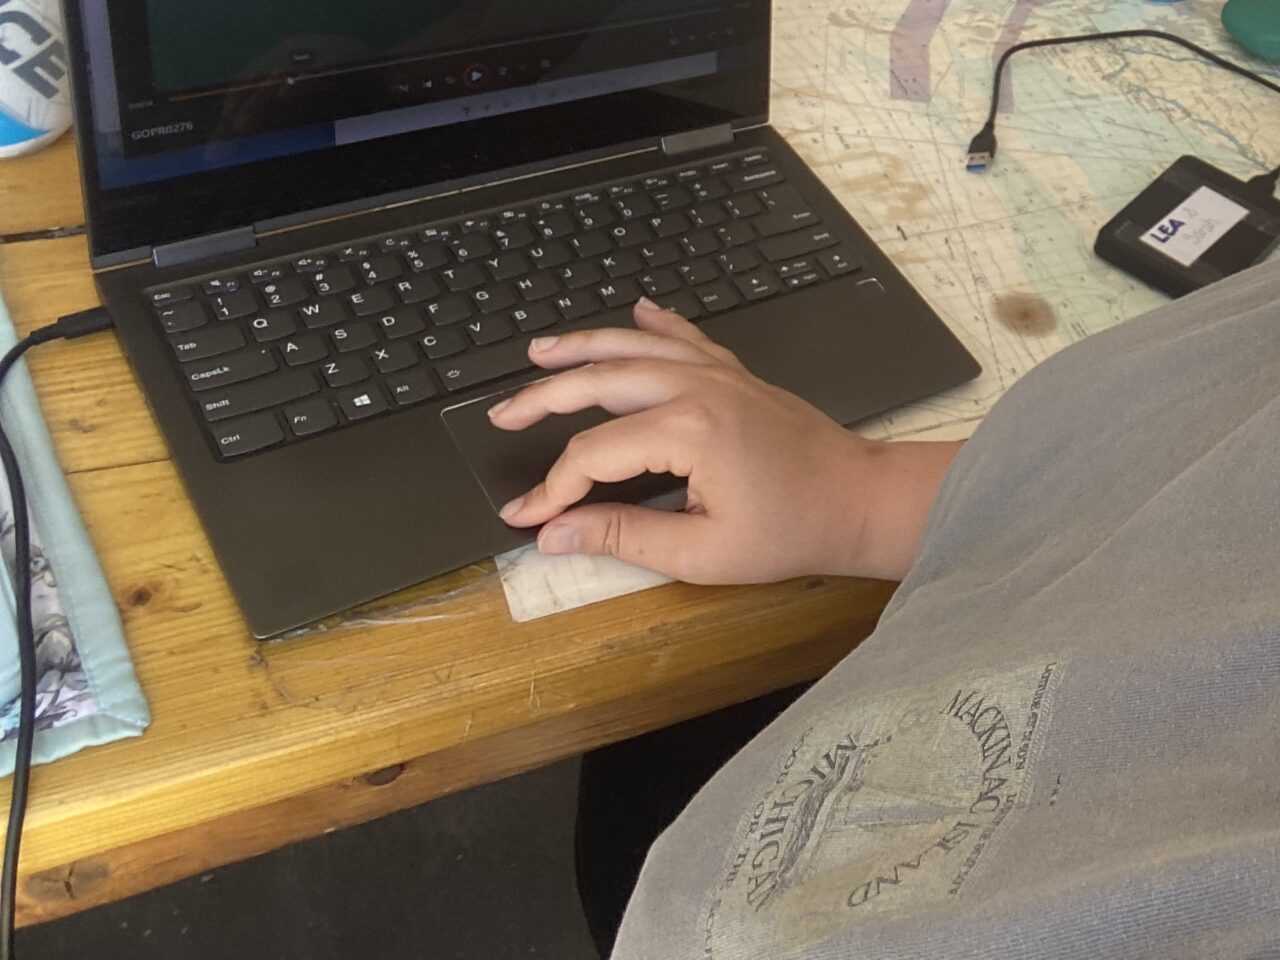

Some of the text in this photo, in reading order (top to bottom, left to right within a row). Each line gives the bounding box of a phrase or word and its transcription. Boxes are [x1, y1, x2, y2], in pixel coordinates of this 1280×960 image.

[131, 120, 194, 140] GOPR0276
[1150, 218, 1185, 244] LEA
[531, 248, 543, 258] U
[642, 248, 654, 257] L
[488, 258, 498, 268] Y
[603, 256, 616, 267] K
[444, 270, 454, 279] T
[564, 268, 572, 278] J
[320, 282, 330, 292] 3
[398, 282, 412, 292] R
[518, 278, 532, 290] H
[476, 290, 490, 300] G
[601, 286, 616, 296] M
[270, 294, 281, 304] 2
[351, 293, 364, 304] E
[558, 298, 572, 308] N
[221, 308, 229, 317] 1
[302, 304, 320, 316] W
[428, 304, 440, 314] F
[514, 310, 528, 320] B
[253, 318, 268, 328] Q
[382, 316, 396, 327] D
[470, 322, 481, 333] V
[334, 329, 348, 340] S
[424, 336, 438, 346] C
[177, 342, 197, 352] Tab
[286, 342, 299, 353] A
[375, 348, 390, 360] X
[325, 362, 340, 374] Z
[192, 366, 230, 381] CapsLk
[396, 384, 410, 394] Alt
[206, 399, 230, 411] Shift
[294, 415, 308, 424] Fn
[220, 434, 241, 445] Ctrl
[939, 689, 1013, 815] MACKINAC
[747, 732, 858, 913] MICHIGAN
[718, 847, 750, 890] THE
[847, 820, 981, 908] ISLAND
